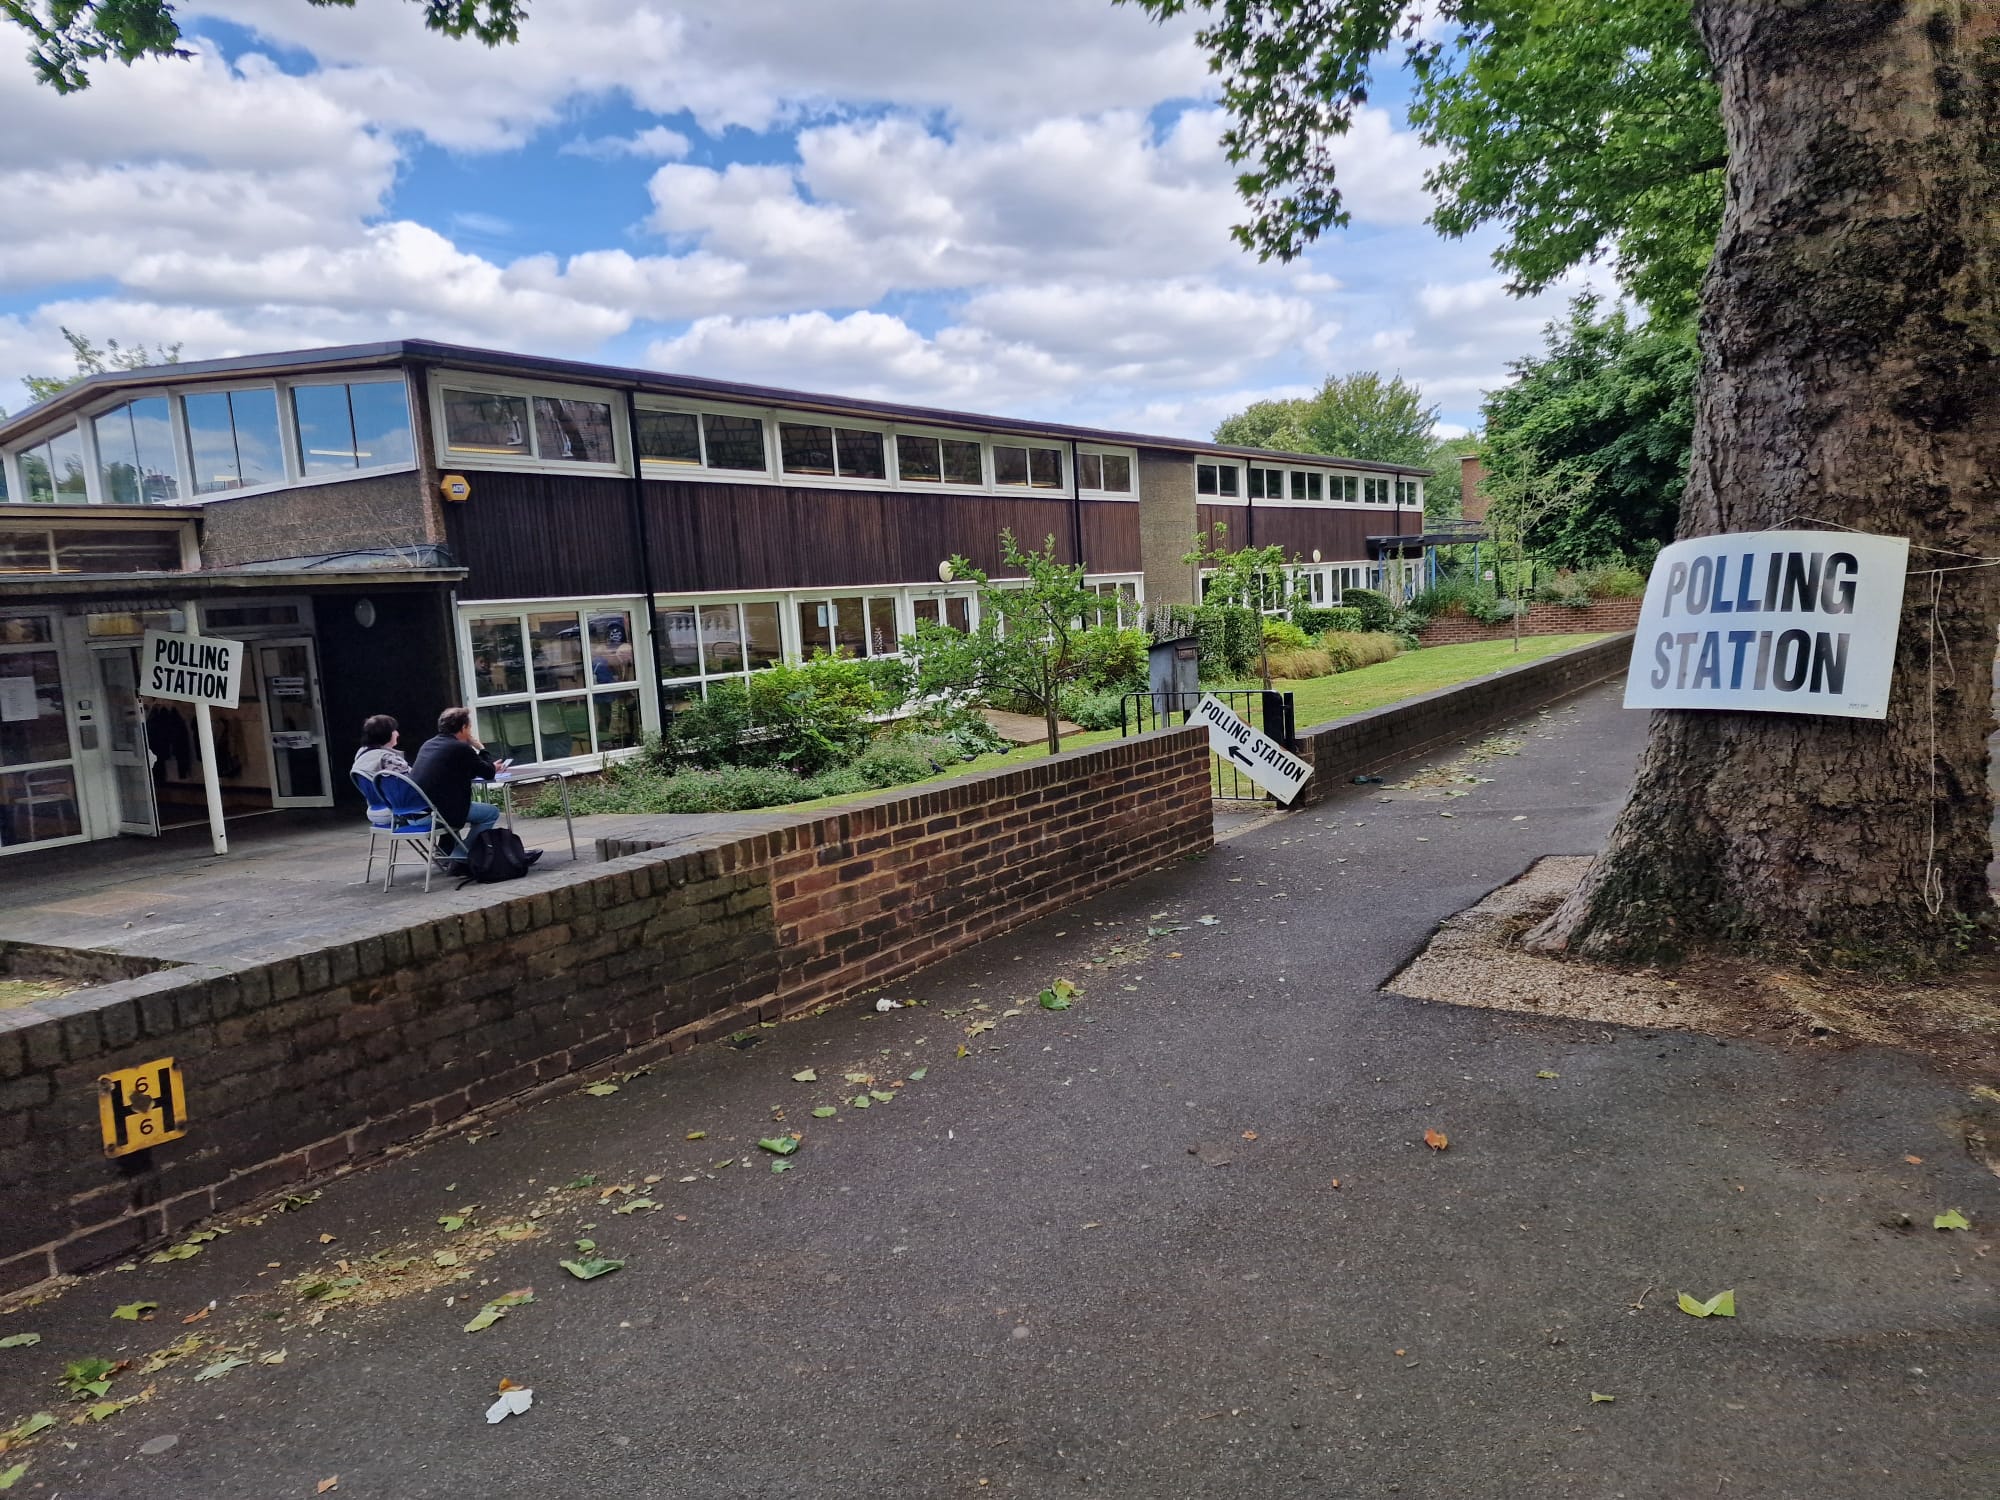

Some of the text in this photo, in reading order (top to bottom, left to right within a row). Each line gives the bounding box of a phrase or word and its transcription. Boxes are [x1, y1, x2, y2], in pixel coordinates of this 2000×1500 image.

[1662, 552, 1859, 618] POLLING
[155, 638, 229, 672] POLLING
[1650, 628, 1851, 695] STATION
[152, 665, 228, 700] STATION
[1200, 700, 1306, 783] POLLING STATION
[112, 1067, 175, 1146] H
[135, 1076, 149, 1094] 6
[140, 1118, 154, 1135] 6
